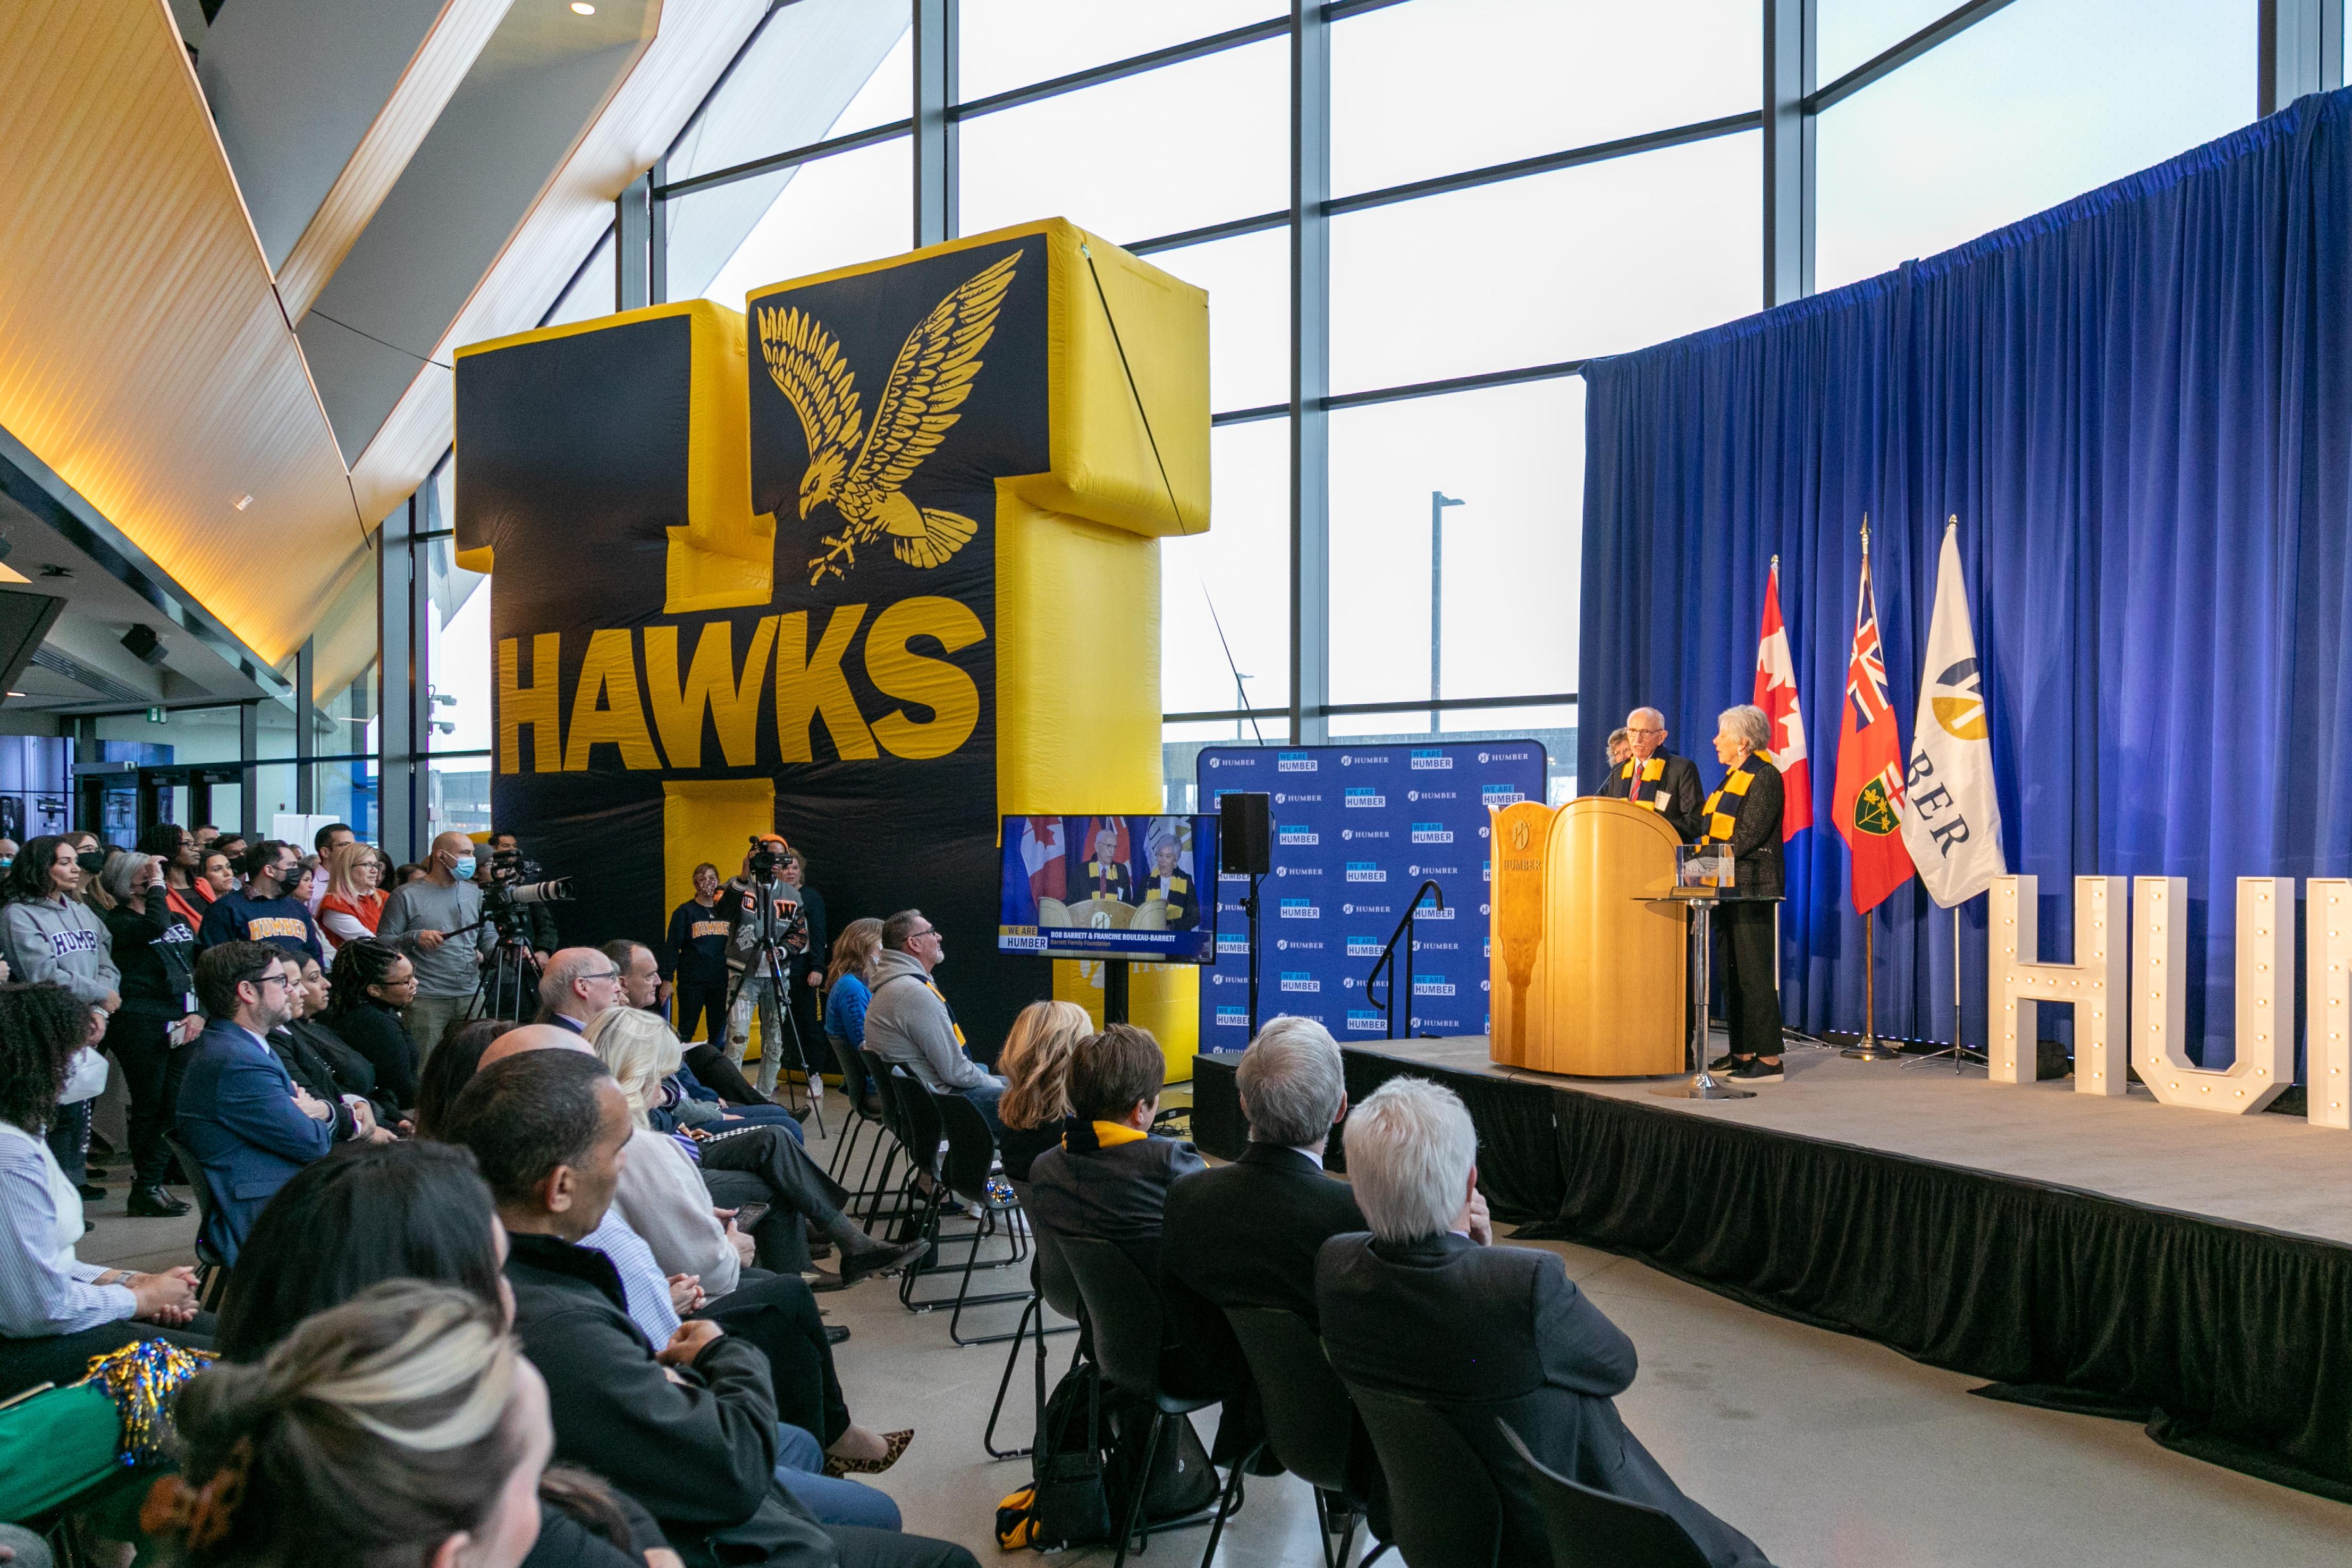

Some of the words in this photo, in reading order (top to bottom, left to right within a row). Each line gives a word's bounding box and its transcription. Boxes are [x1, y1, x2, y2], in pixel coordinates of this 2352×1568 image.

[496, 595, 988, 775] HAWKS
[1279, 761, 1316, 770] HUMBER
[1412, 759, 1451, 768] HUMBER
[1346, 797, 1384, 806] HUMBER
[1484, 794, 1524, 804] HUMBER
[1281, 834, 1317, 844] HUMBER
[1413, 832, 1452, 842] HUMBER
[1504, 859, 1542, 871] HUMBER
[1348, 872, 1385, 880] HUMBER
[1282, 908, 1318, 917] HUMBER
[1414, 909, 1453, 918] HUMBER
[692, 921, 730, 939] HUMBE
[1008, 926, 1019, 935] WE
[1021, 927, 1036, 935] ARE
[52, 929, 98, 957] HUMB
[1007, 937, 1046, 948] HUMBER
[1348, 946, 1386, 955] HUMBER
[1282, 982, 1318, 990] HUMBER
[1415, 985, 1454, 994] HUMBER
[1348, 1020, 1386, 1029] HUMBER
